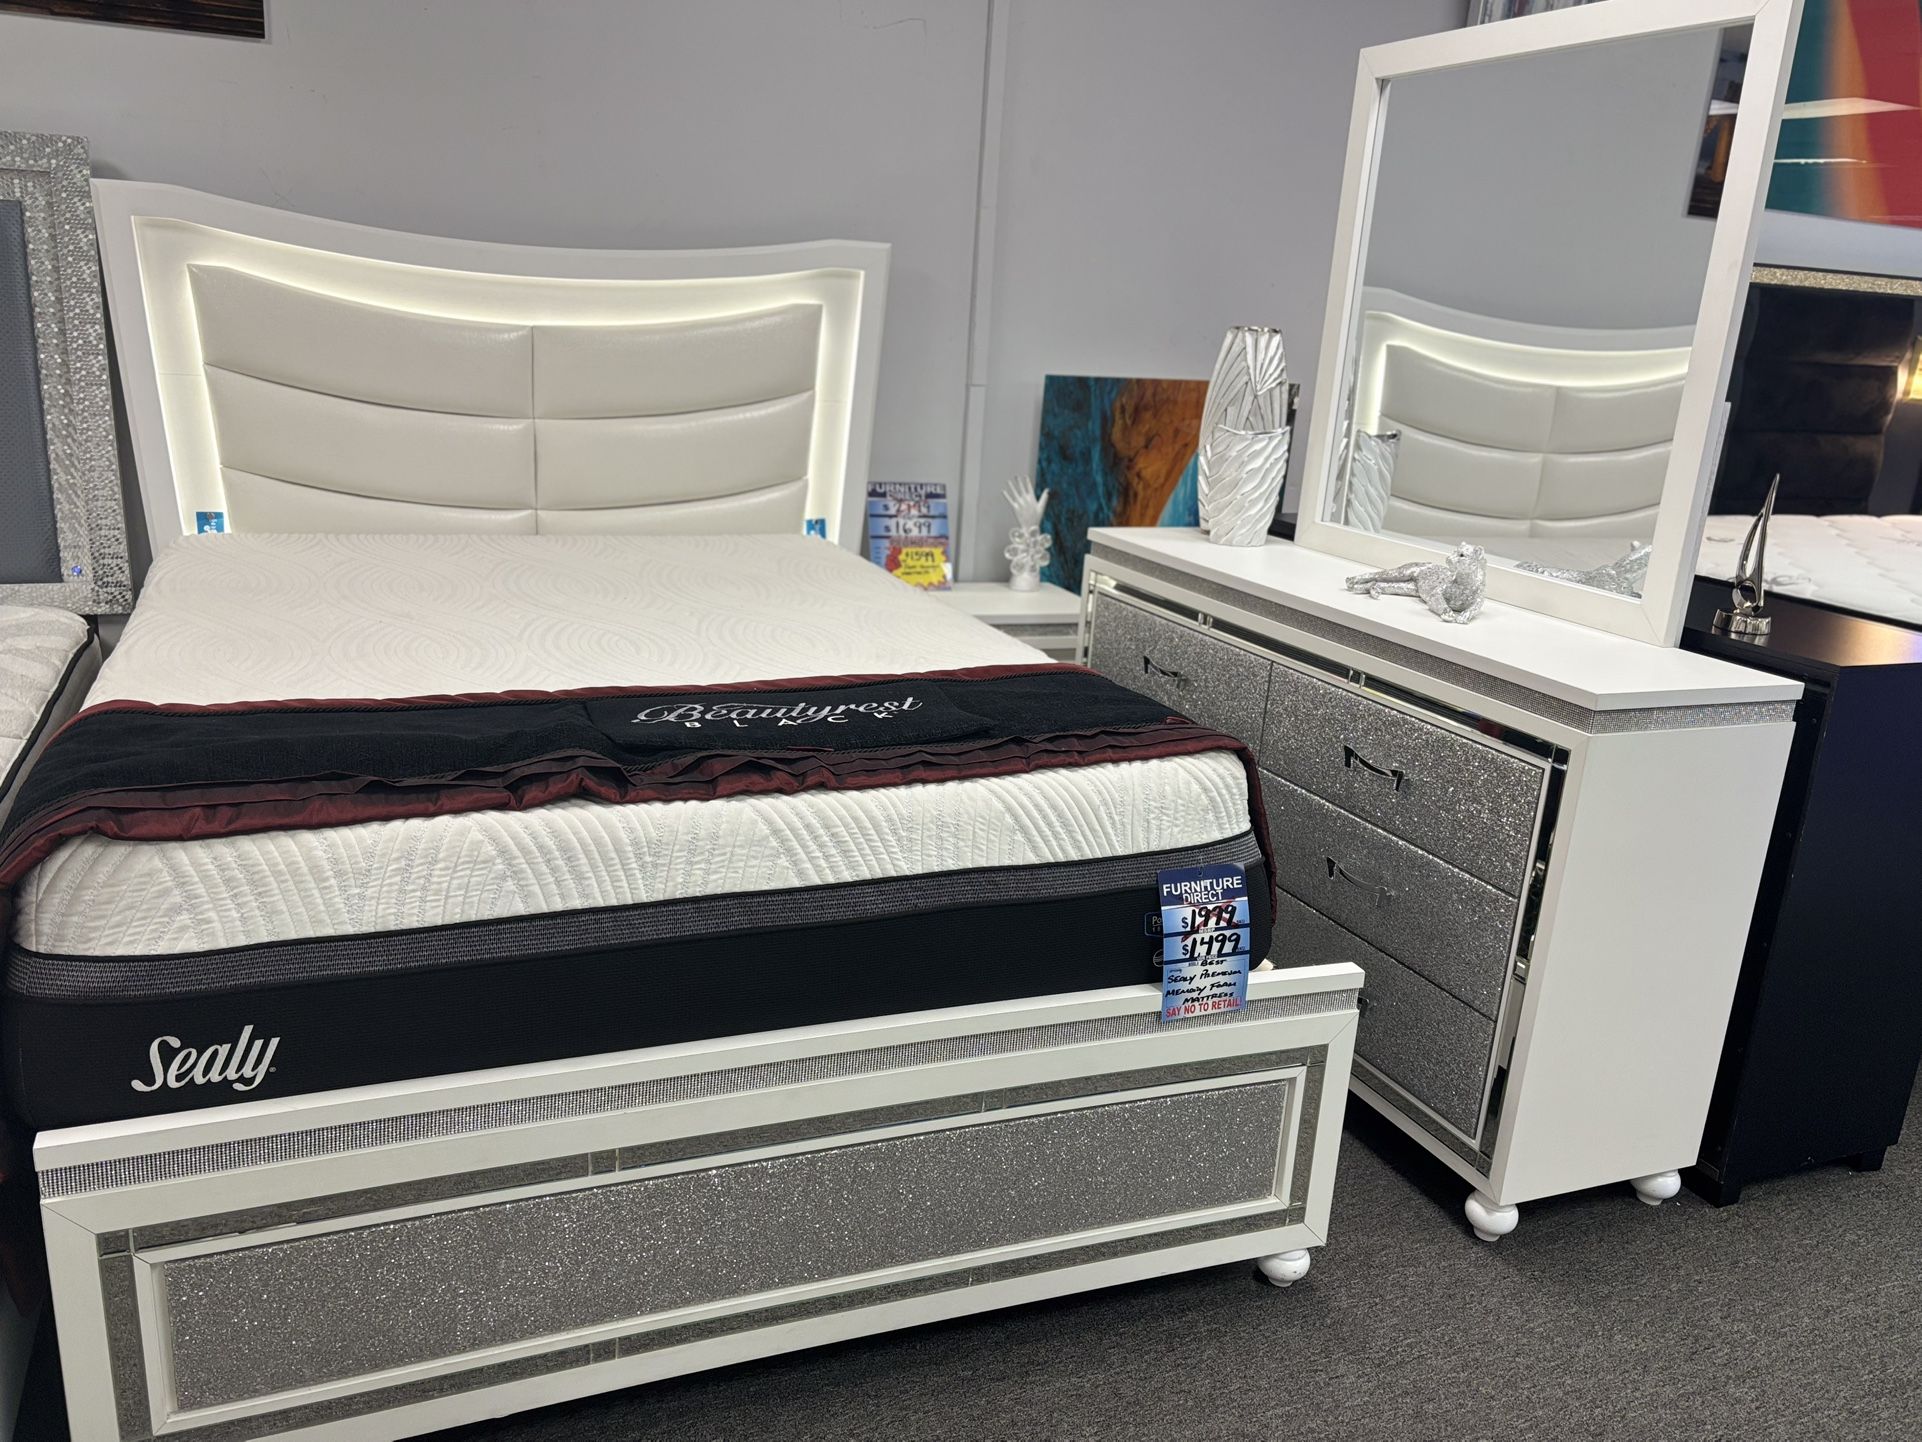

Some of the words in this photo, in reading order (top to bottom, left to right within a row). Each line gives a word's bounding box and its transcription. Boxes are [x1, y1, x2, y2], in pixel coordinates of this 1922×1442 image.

[868, 483, 945, 495] FURNITURE
[631, 696, 923, 724] Beautyrest
[1163, 876, 1243, 897] FURNITURE
[1182, 889, 1223, 905] DIRECT
[1200, 959, 1227, 967] BEST
[1209, 981, 1237, 991] FOAM
[1182, 992, 1235, 1005] MATTRESS
[1166, 1006, 1182, 1018] SAY
[1184, 1004, 1196, 1015] NO
[1199, 1002, 1210, 1013] TO
[131, 1024, 281, 1092] Sealy
